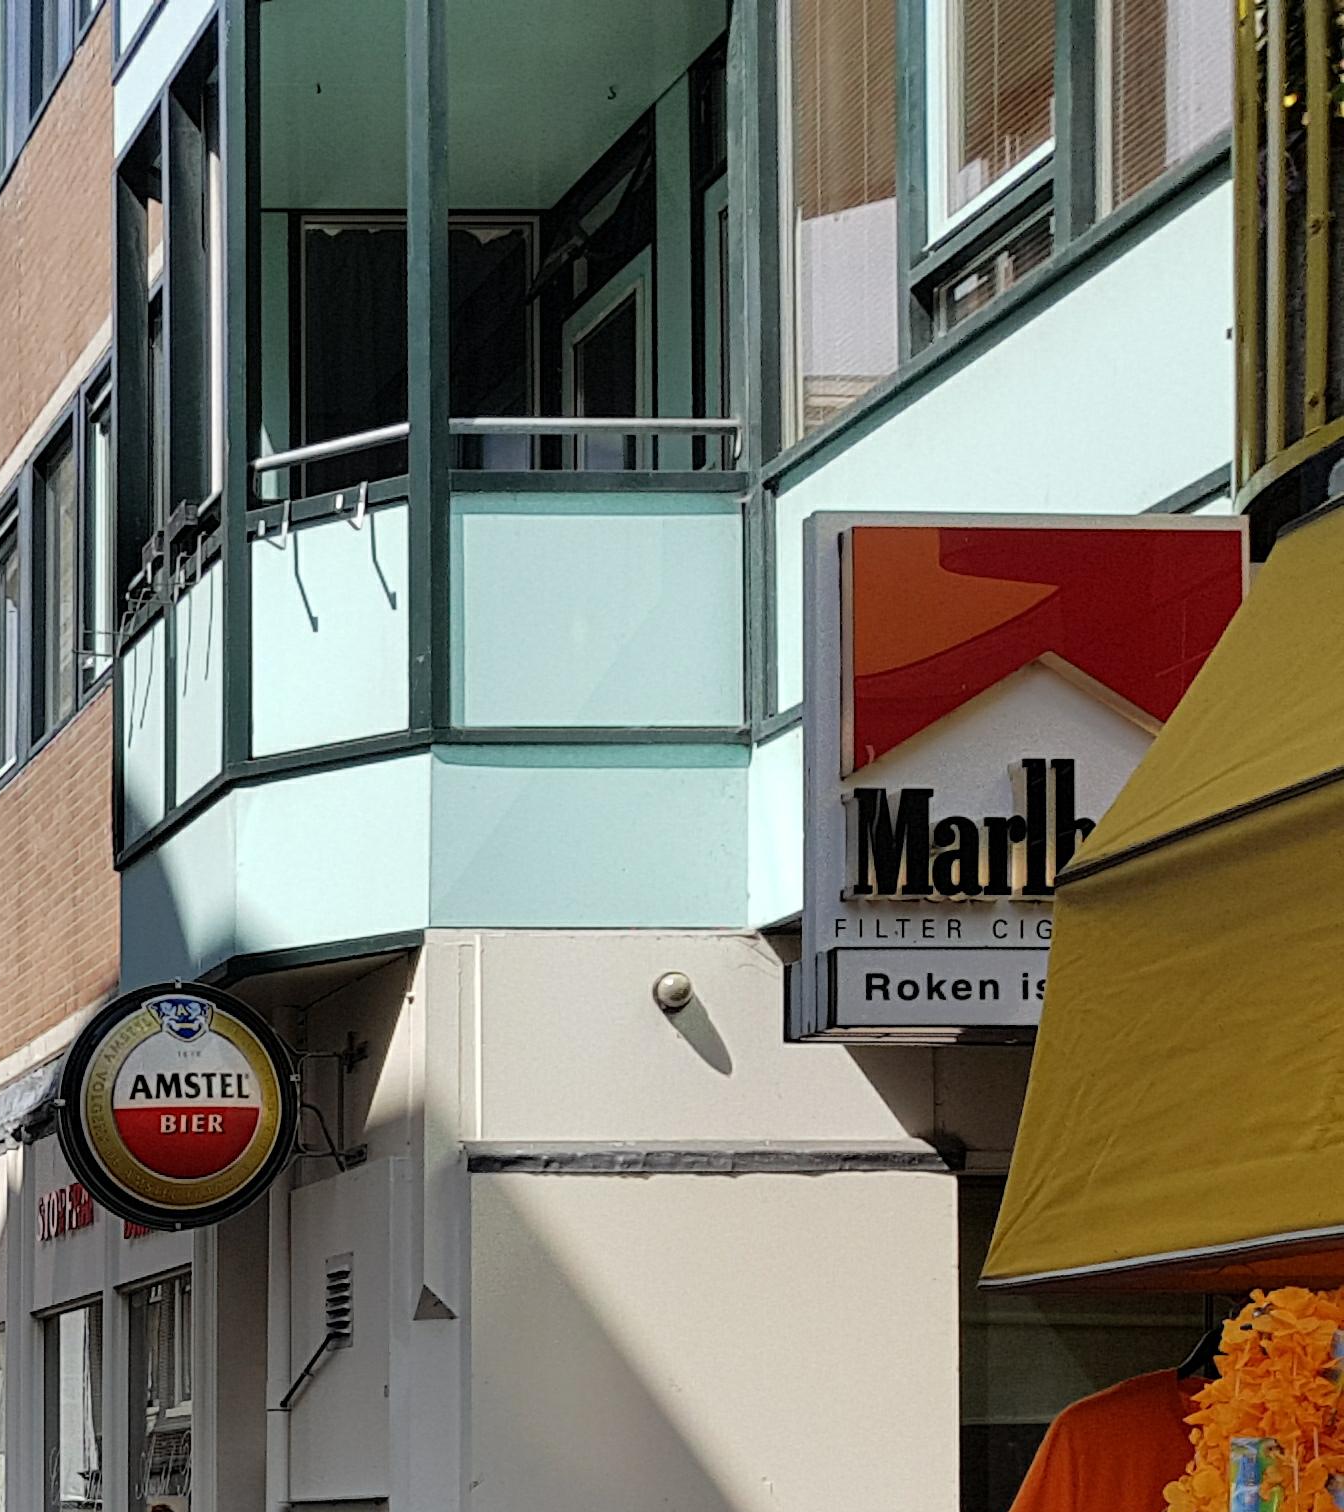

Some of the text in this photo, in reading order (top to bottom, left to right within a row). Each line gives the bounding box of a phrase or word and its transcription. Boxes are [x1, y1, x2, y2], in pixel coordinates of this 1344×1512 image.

[834, 918, 962, 939] FILTER
[864, 971, 1001, 1002] Roken
[128, 1071, 251, 1101] AMSTEL
[159, 1113, 224, 1134] BIER
